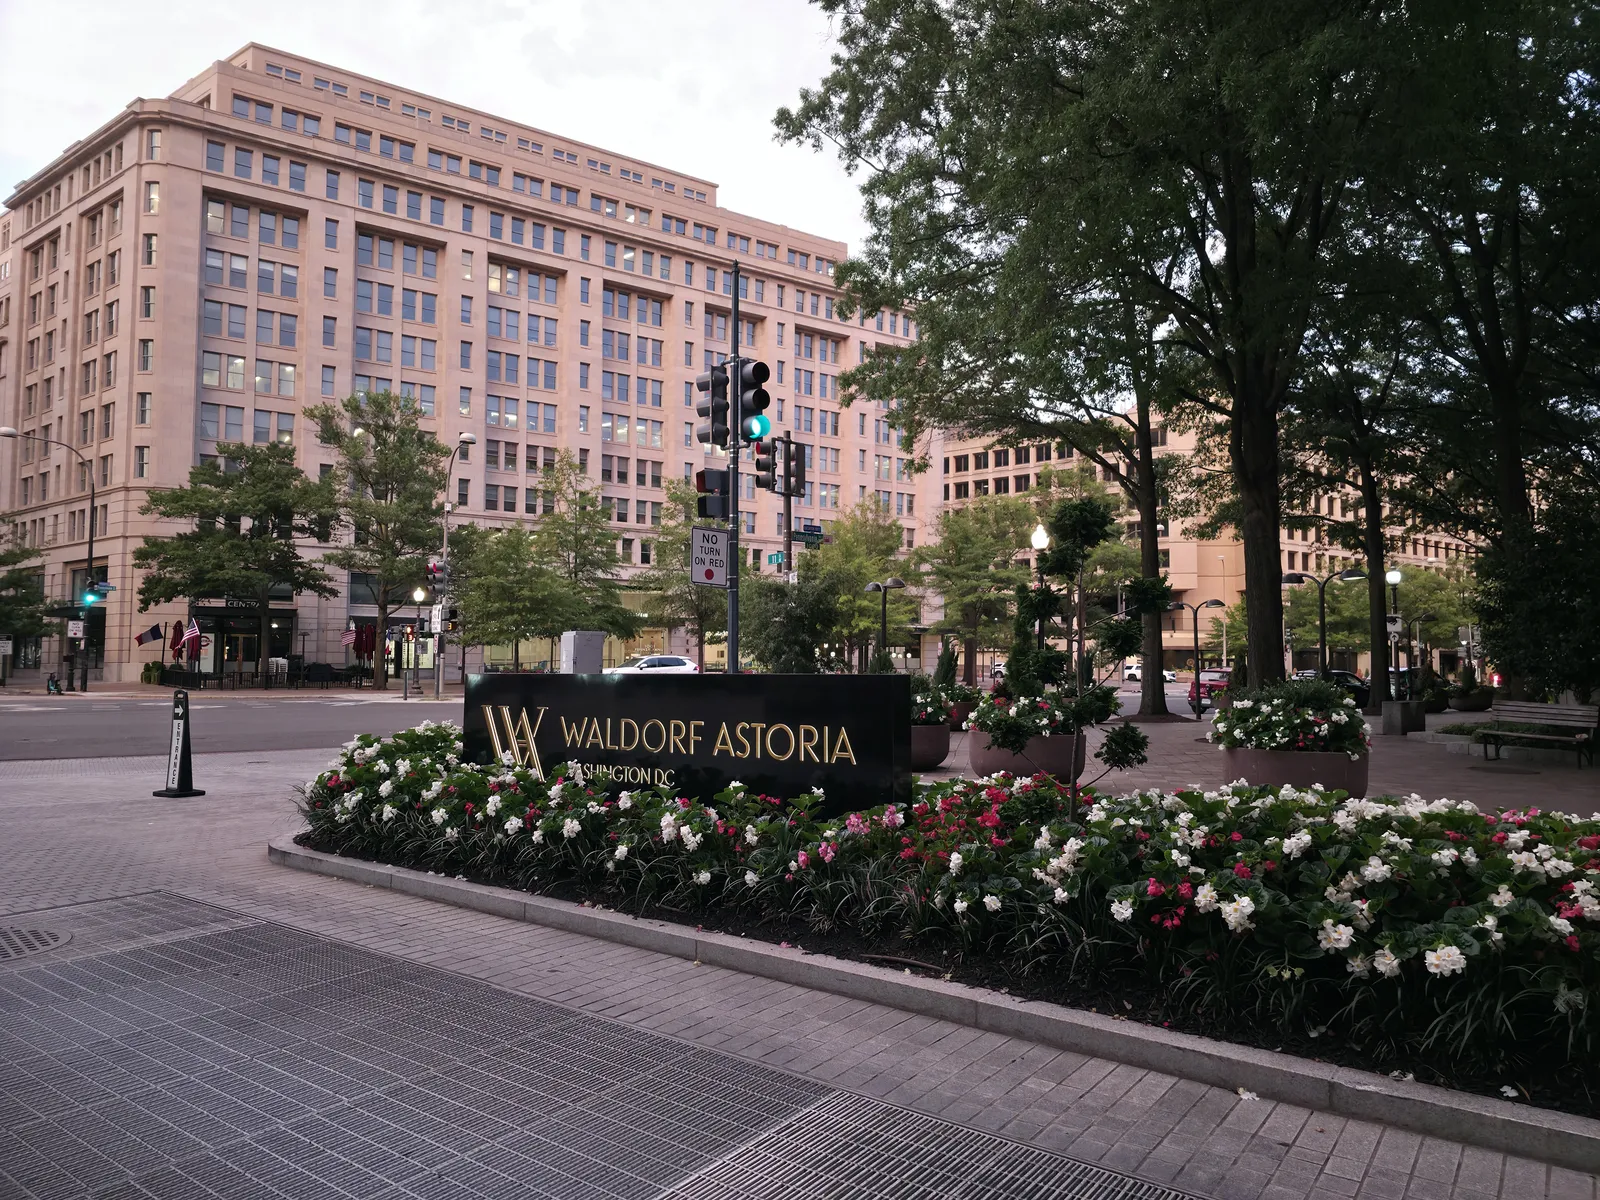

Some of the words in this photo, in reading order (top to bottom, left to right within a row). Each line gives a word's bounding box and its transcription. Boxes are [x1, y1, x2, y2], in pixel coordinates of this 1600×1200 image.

[702, 533, 718, 545] NO
[700, 546, 721, 557] TURN
[694, 556, 706, 566] ON
[709, 558, 725, 569] RED
[227, 600, 260, 608] CENTRA
[559, 715, 705, 755] WALDORF
[712, 721, 857, 766] ASTORIA
[171, 722, 181, 785] ENTRANCE
[654, 767, 676, 787] DC
